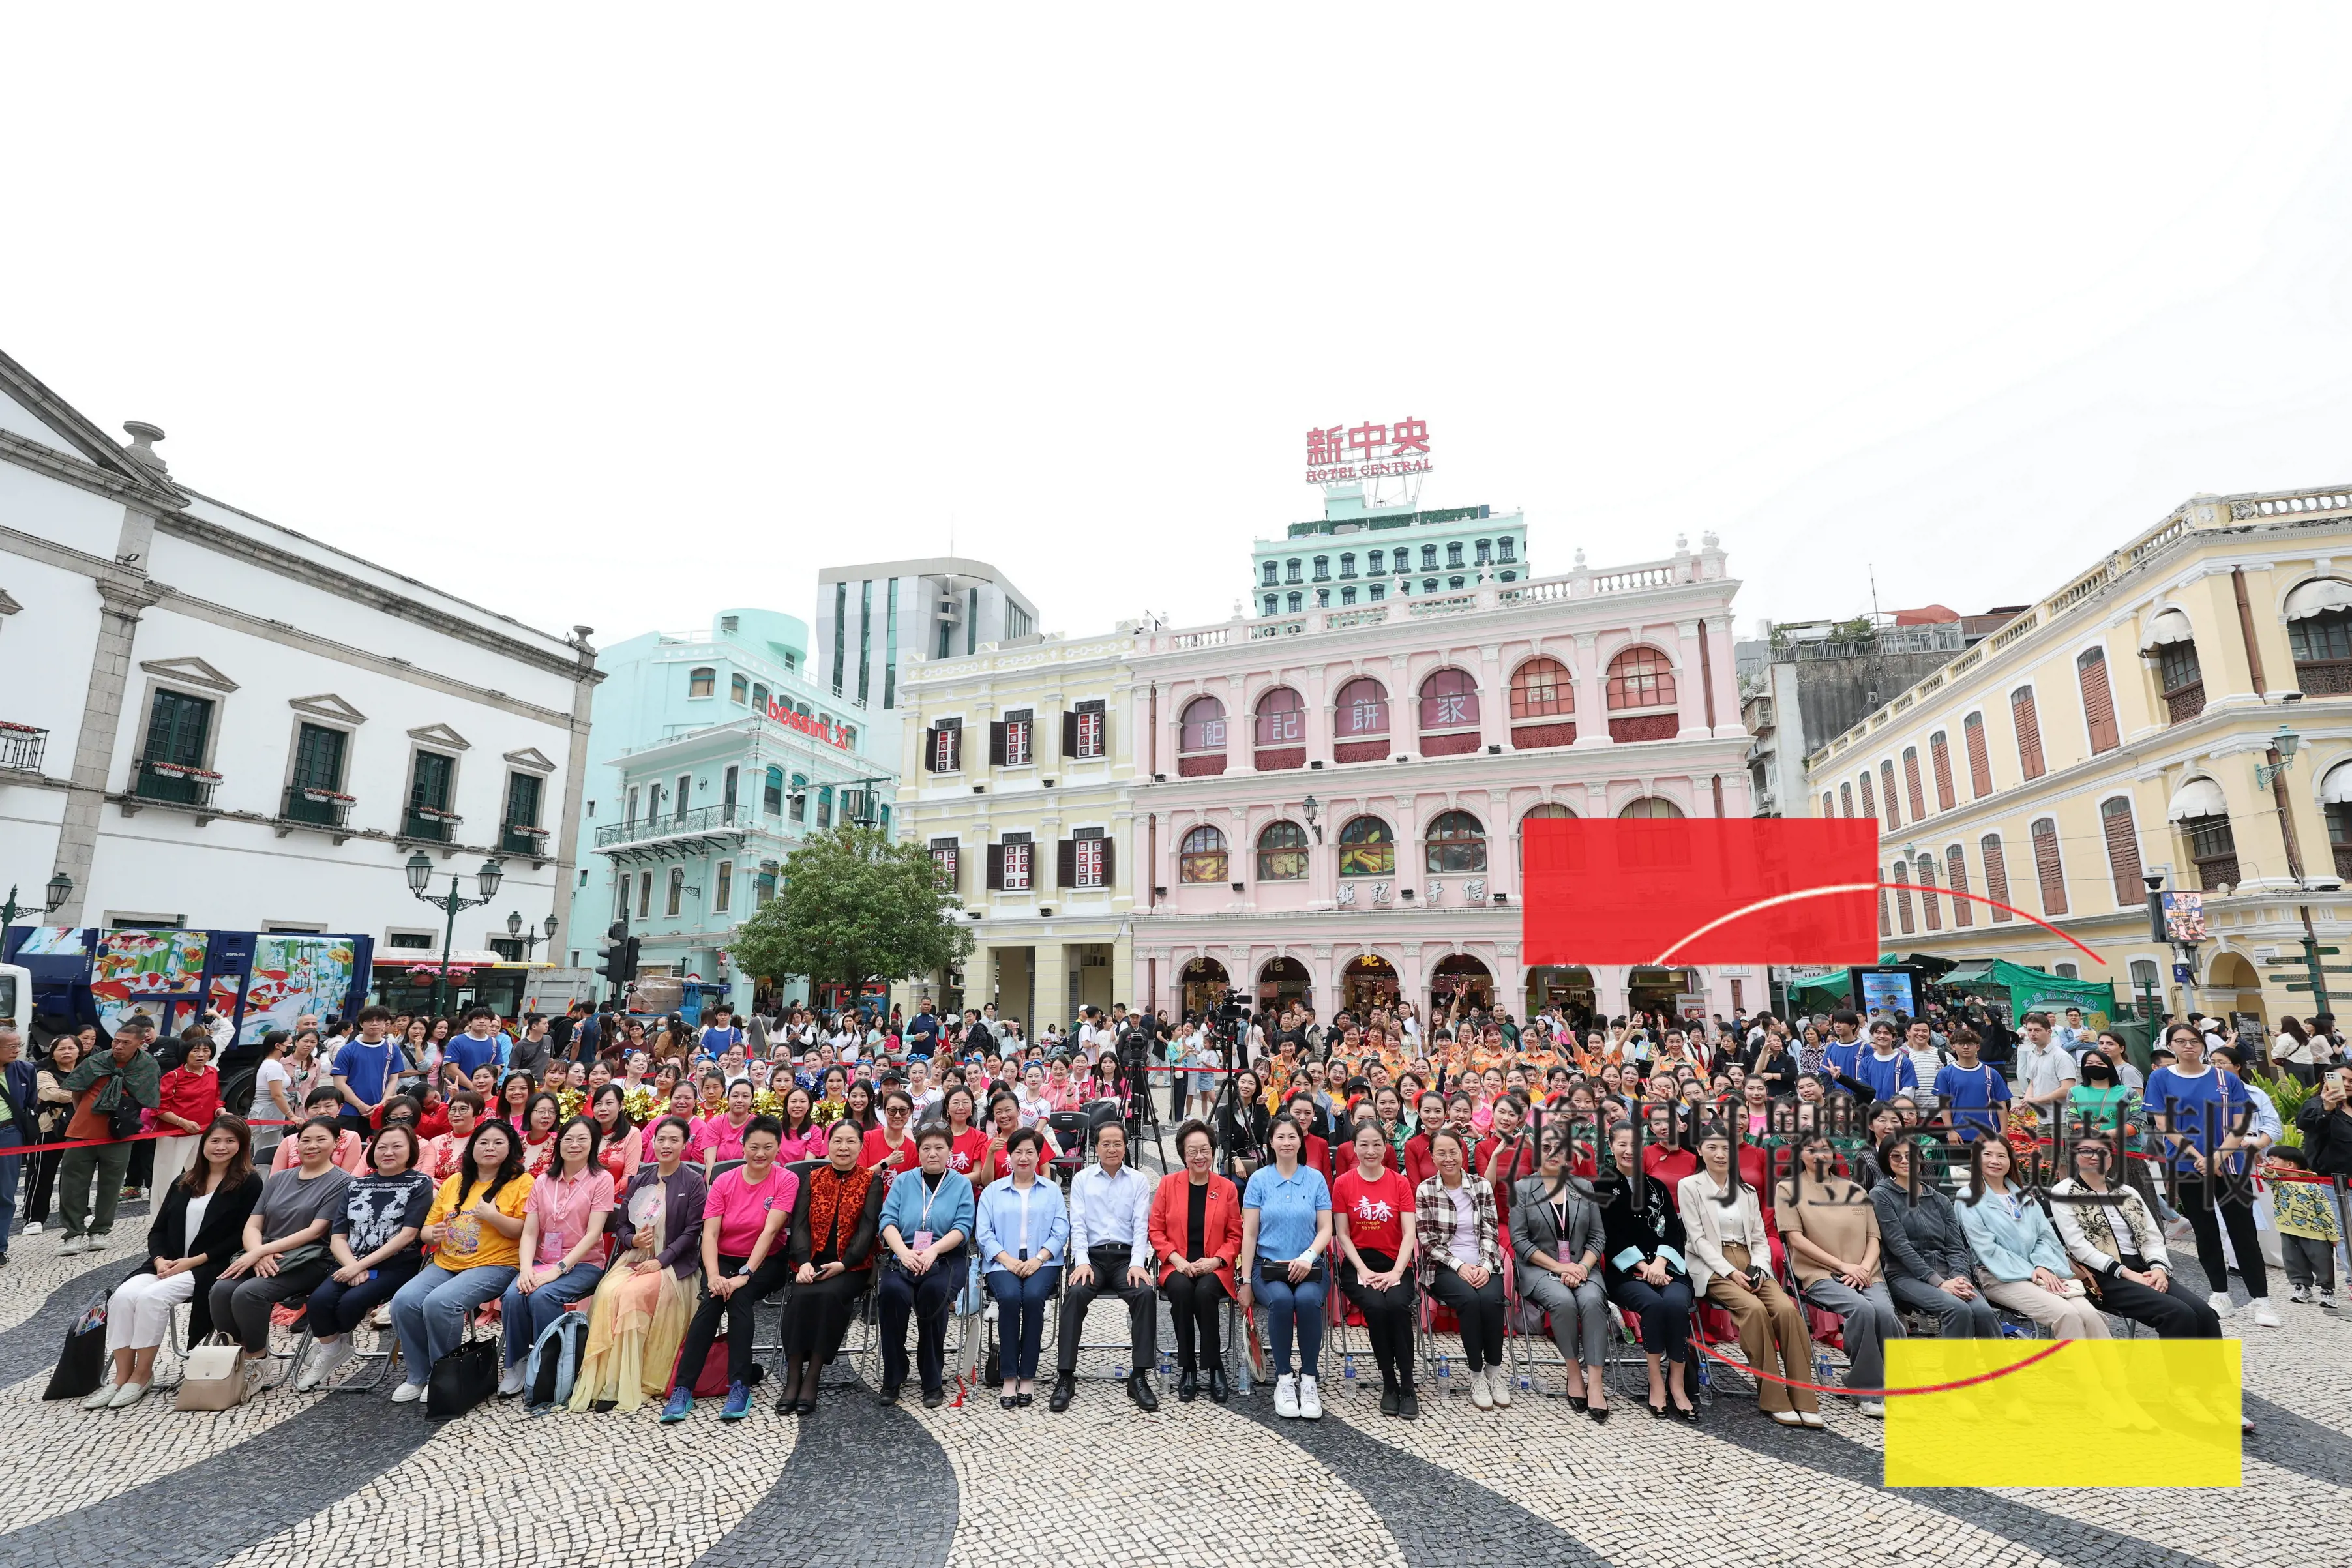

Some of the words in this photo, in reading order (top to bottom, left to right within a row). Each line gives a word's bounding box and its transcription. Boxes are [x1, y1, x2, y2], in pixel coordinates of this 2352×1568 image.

[1306, 416, 1430, 466] 新中央
[1306, 467, 1357, 482] HOTEL
[1360, 458, 1433, 476] CENTRAL
[1336, 877, 1485, 905] 鉅記手信
[2021, 990, 2098, 1011] 老爺爺冰箱貼
[1020, 1107, 1035, 1117] STAR
[1353, 1194, 1393, 1222] 青春
